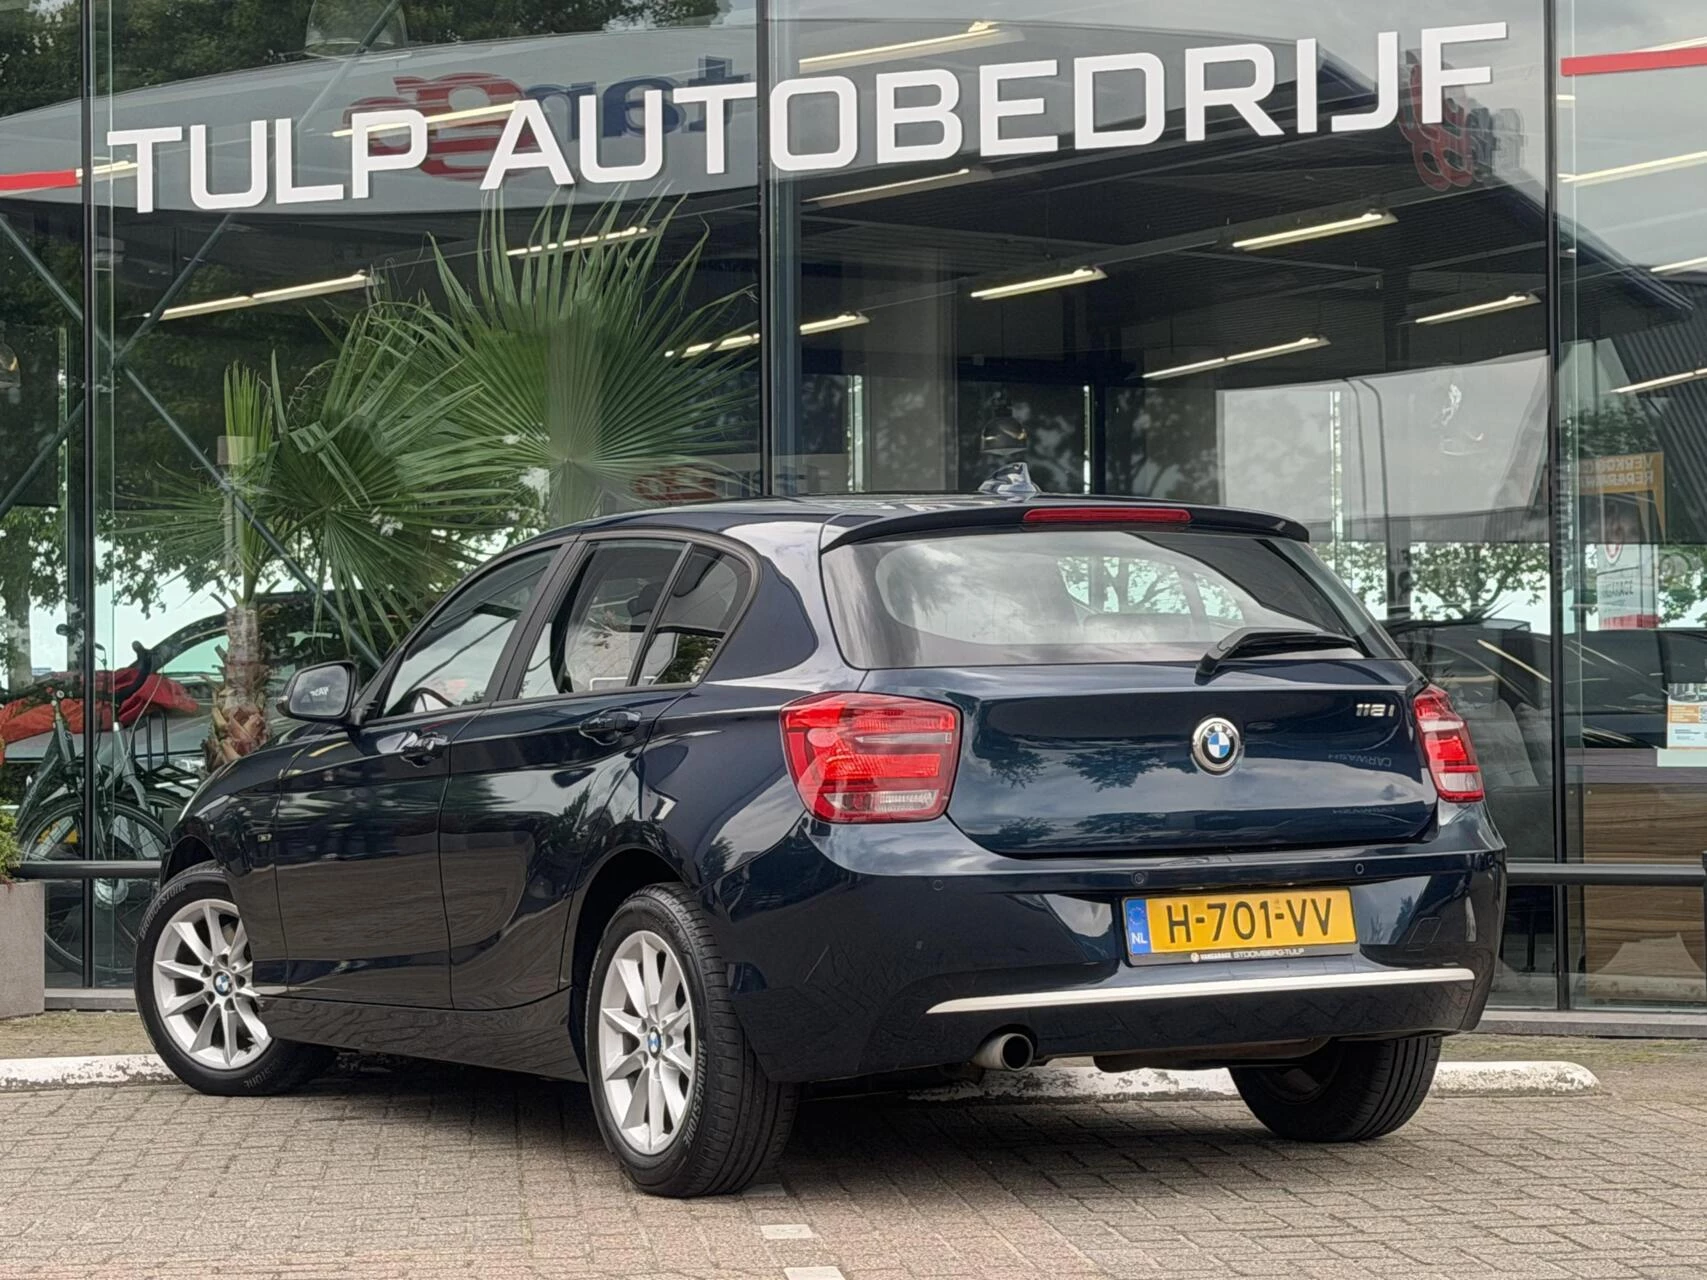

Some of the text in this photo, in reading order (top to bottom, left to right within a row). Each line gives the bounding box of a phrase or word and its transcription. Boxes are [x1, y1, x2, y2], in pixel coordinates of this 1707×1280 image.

[107, 108, 428, 213] TULP
[479, 22, 1508, 191] AUTOBEDRIJF
[1131, 932, 1148, 944] NL
[1166, 897, 1332, 944] H-701-VV
